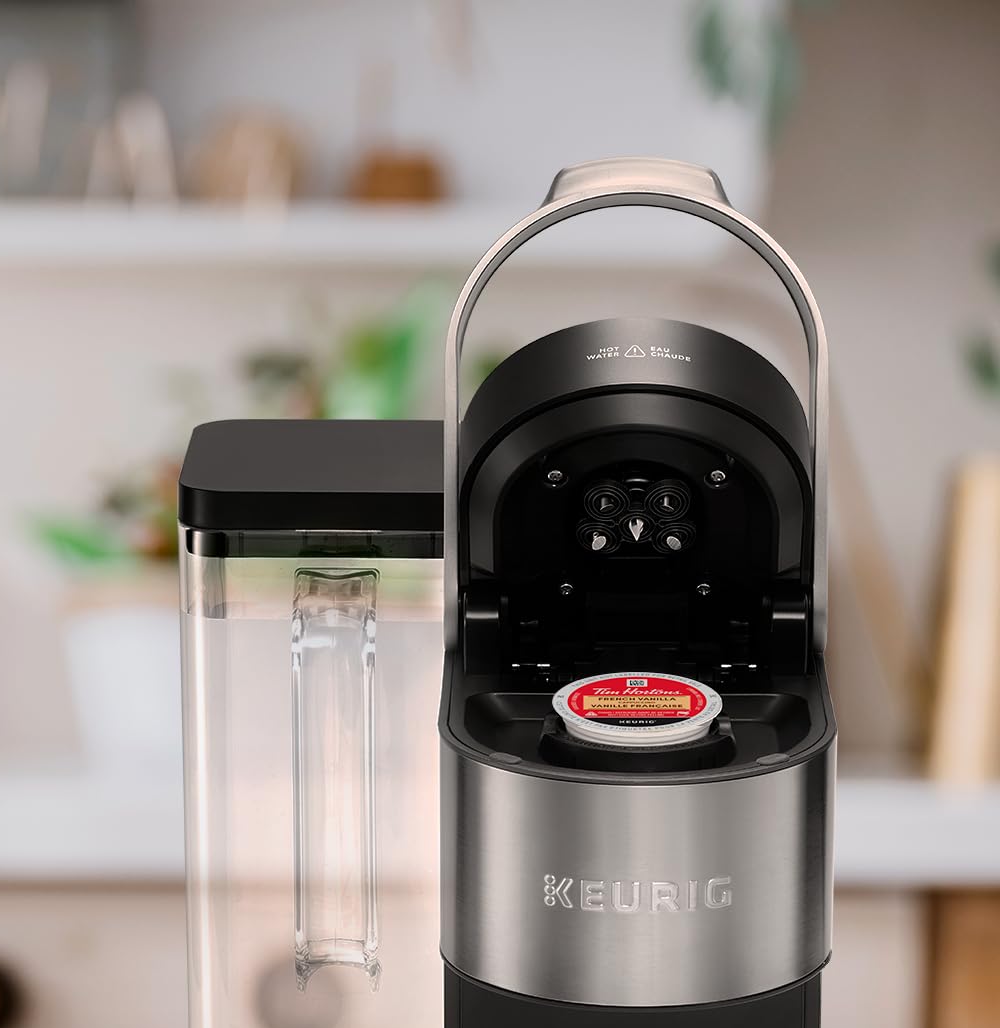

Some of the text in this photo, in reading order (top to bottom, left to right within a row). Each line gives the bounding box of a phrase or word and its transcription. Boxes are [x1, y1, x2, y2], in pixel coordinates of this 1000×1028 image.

[586, 352, 620, 360] WATER
[650, 352, 692, 362] CHAUDE
[544, 874, 732, 912] KEURIG
